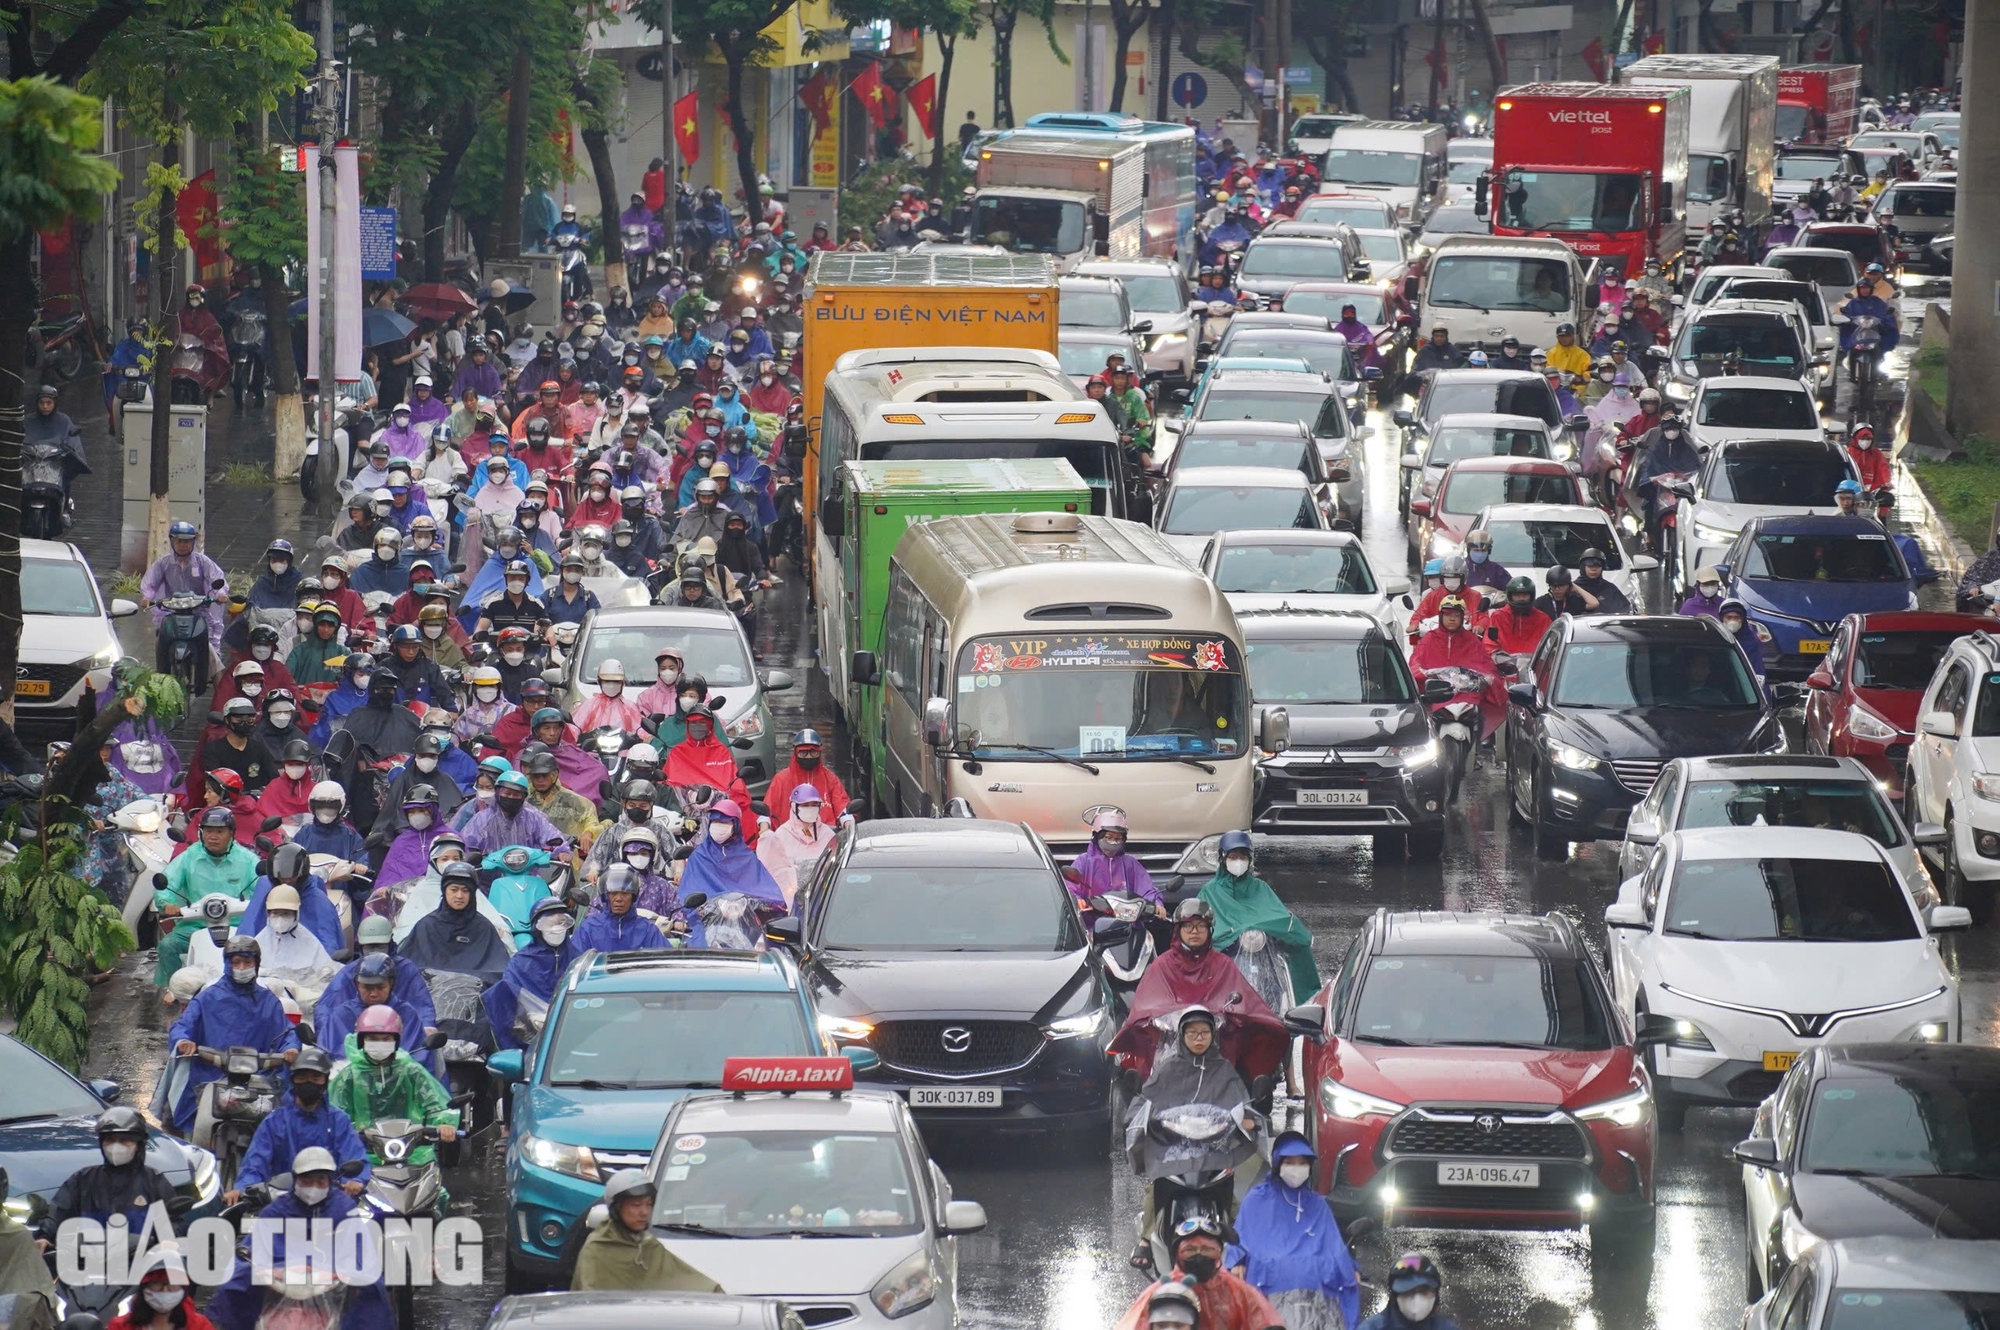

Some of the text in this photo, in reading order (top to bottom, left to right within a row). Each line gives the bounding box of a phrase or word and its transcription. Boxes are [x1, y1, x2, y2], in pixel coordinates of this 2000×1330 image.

[1548, 110, 1612, 124] viettel
[1591, 126, 1612, 134] post
[1580, 243, 1600, 251] post
[816, 304, 1045, 326] BƯU ĐIỆN VIỆT NAM
[1010, 640, 1048, 655] VIP
[1126, 640, 1139, 649] XE
[1141, 640, 1161, 651] HỢP
[1043, 657, 1100, 667] HYUNDAI
[1091, 737, 1116, 753] 08
[1302, 793, 1362, 803] 30L-031.24
[731, 1066, 845, 1084] Alpha.taxi
[917, 1090, 995, 1104] 30K-037.89
[678, 1138, 701, 1148] 365
[1447, 1167, 1531, 1183] 23A-096.47
